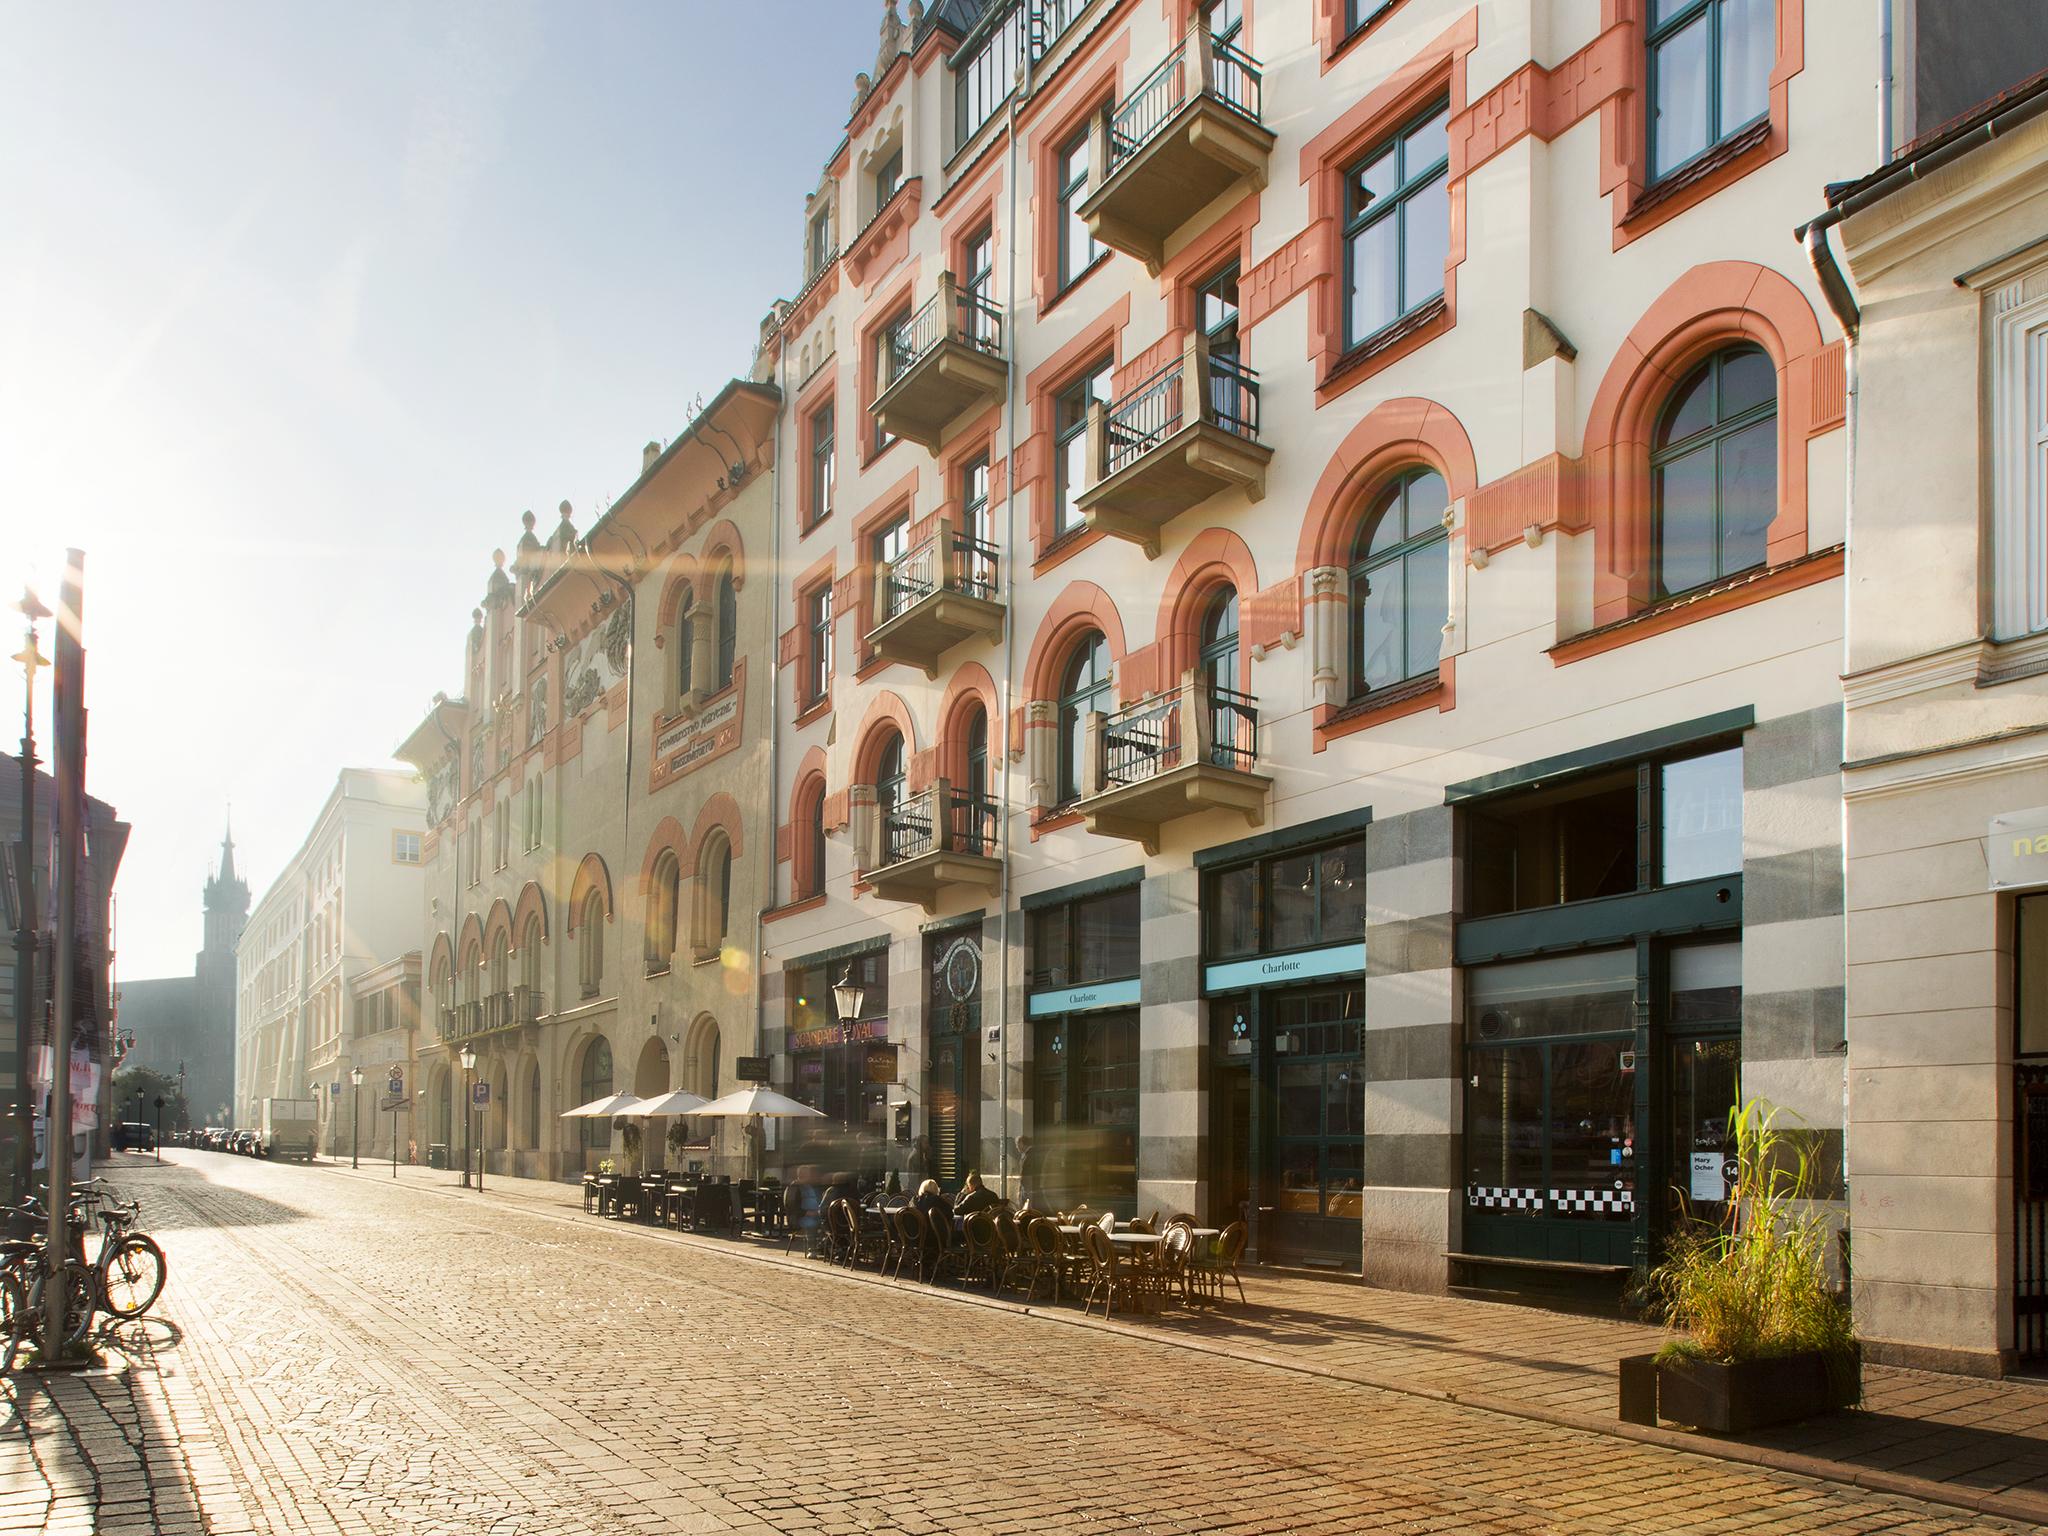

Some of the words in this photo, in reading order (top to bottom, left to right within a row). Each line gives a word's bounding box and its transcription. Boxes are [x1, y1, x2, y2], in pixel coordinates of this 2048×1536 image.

[1262, 961, 1300, 974] Charlotte
[1070, 993, 1097, 1003] Charlotte
[795, 1027, 838, 1048] SCANDALE
[1726, 1167, 1738, 1175] 14
